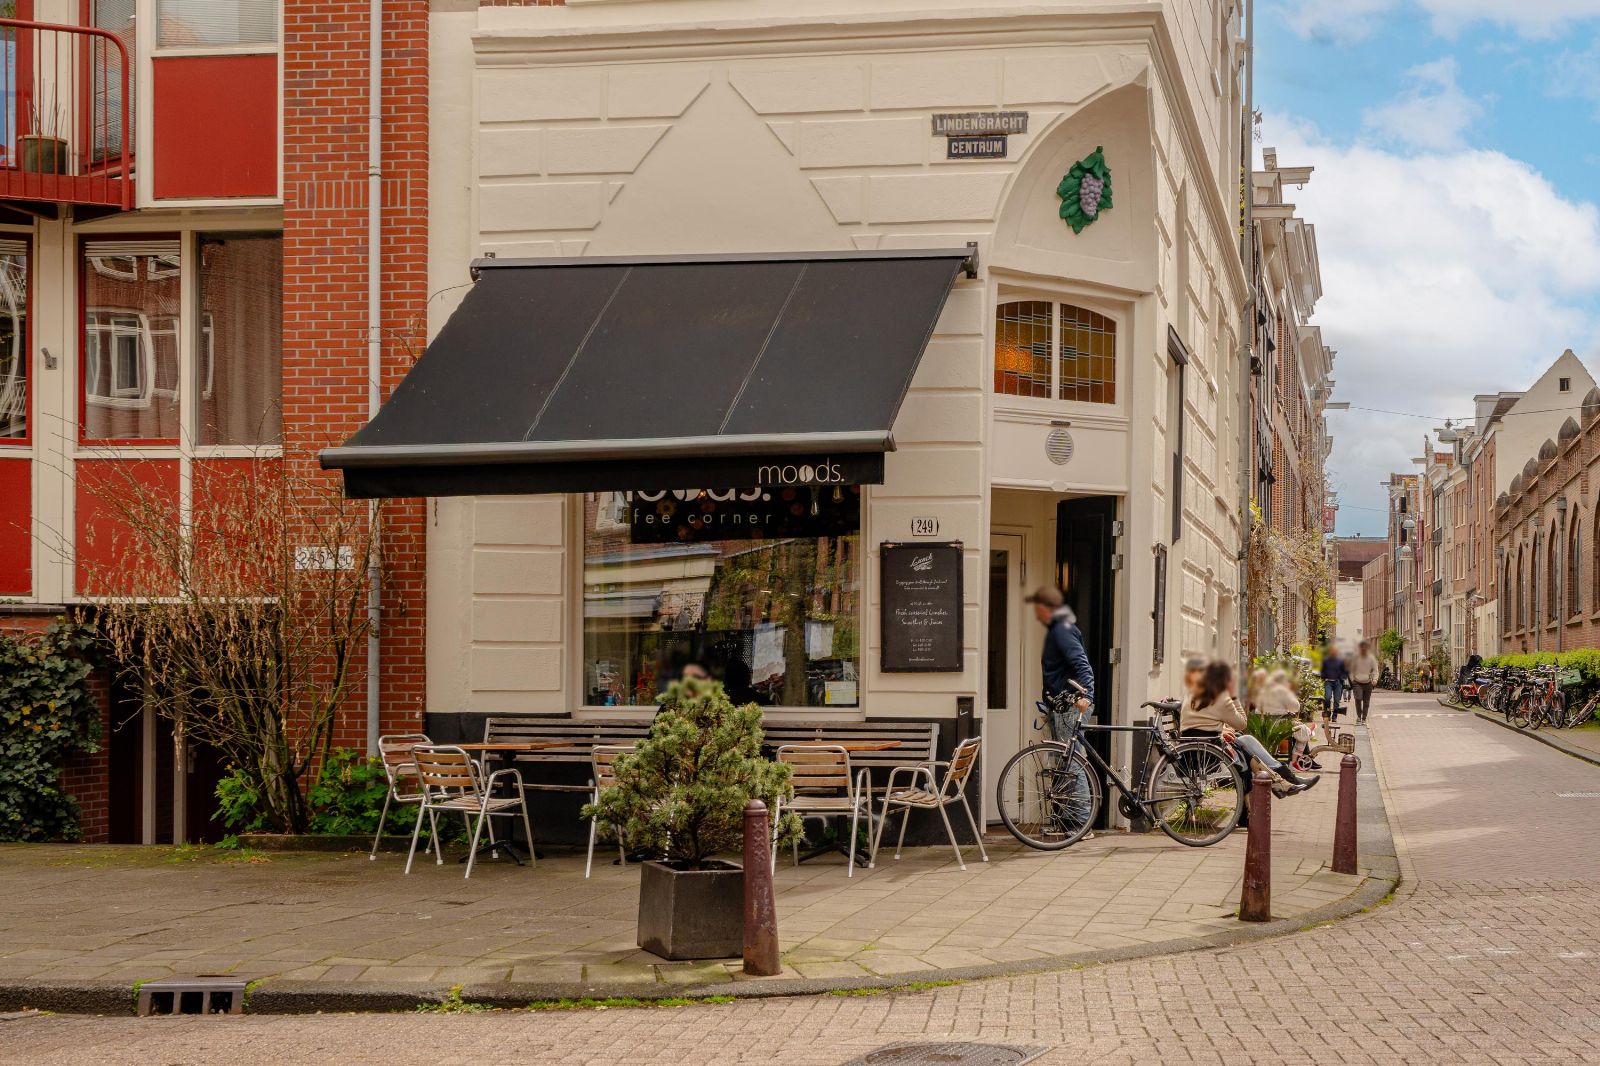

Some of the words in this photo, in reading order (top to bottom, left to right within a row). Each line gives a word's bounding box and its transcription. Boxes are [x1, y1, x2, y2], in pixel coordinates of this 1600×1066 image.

[936, 117, 1024, 131] LINDENGRACHT
[951, 140, 1003, 154] CENTRUM
[758, 456, 845, 483] moods.
[687, 512, 772, 524] corner
[916, 519, 933, 534] 249
